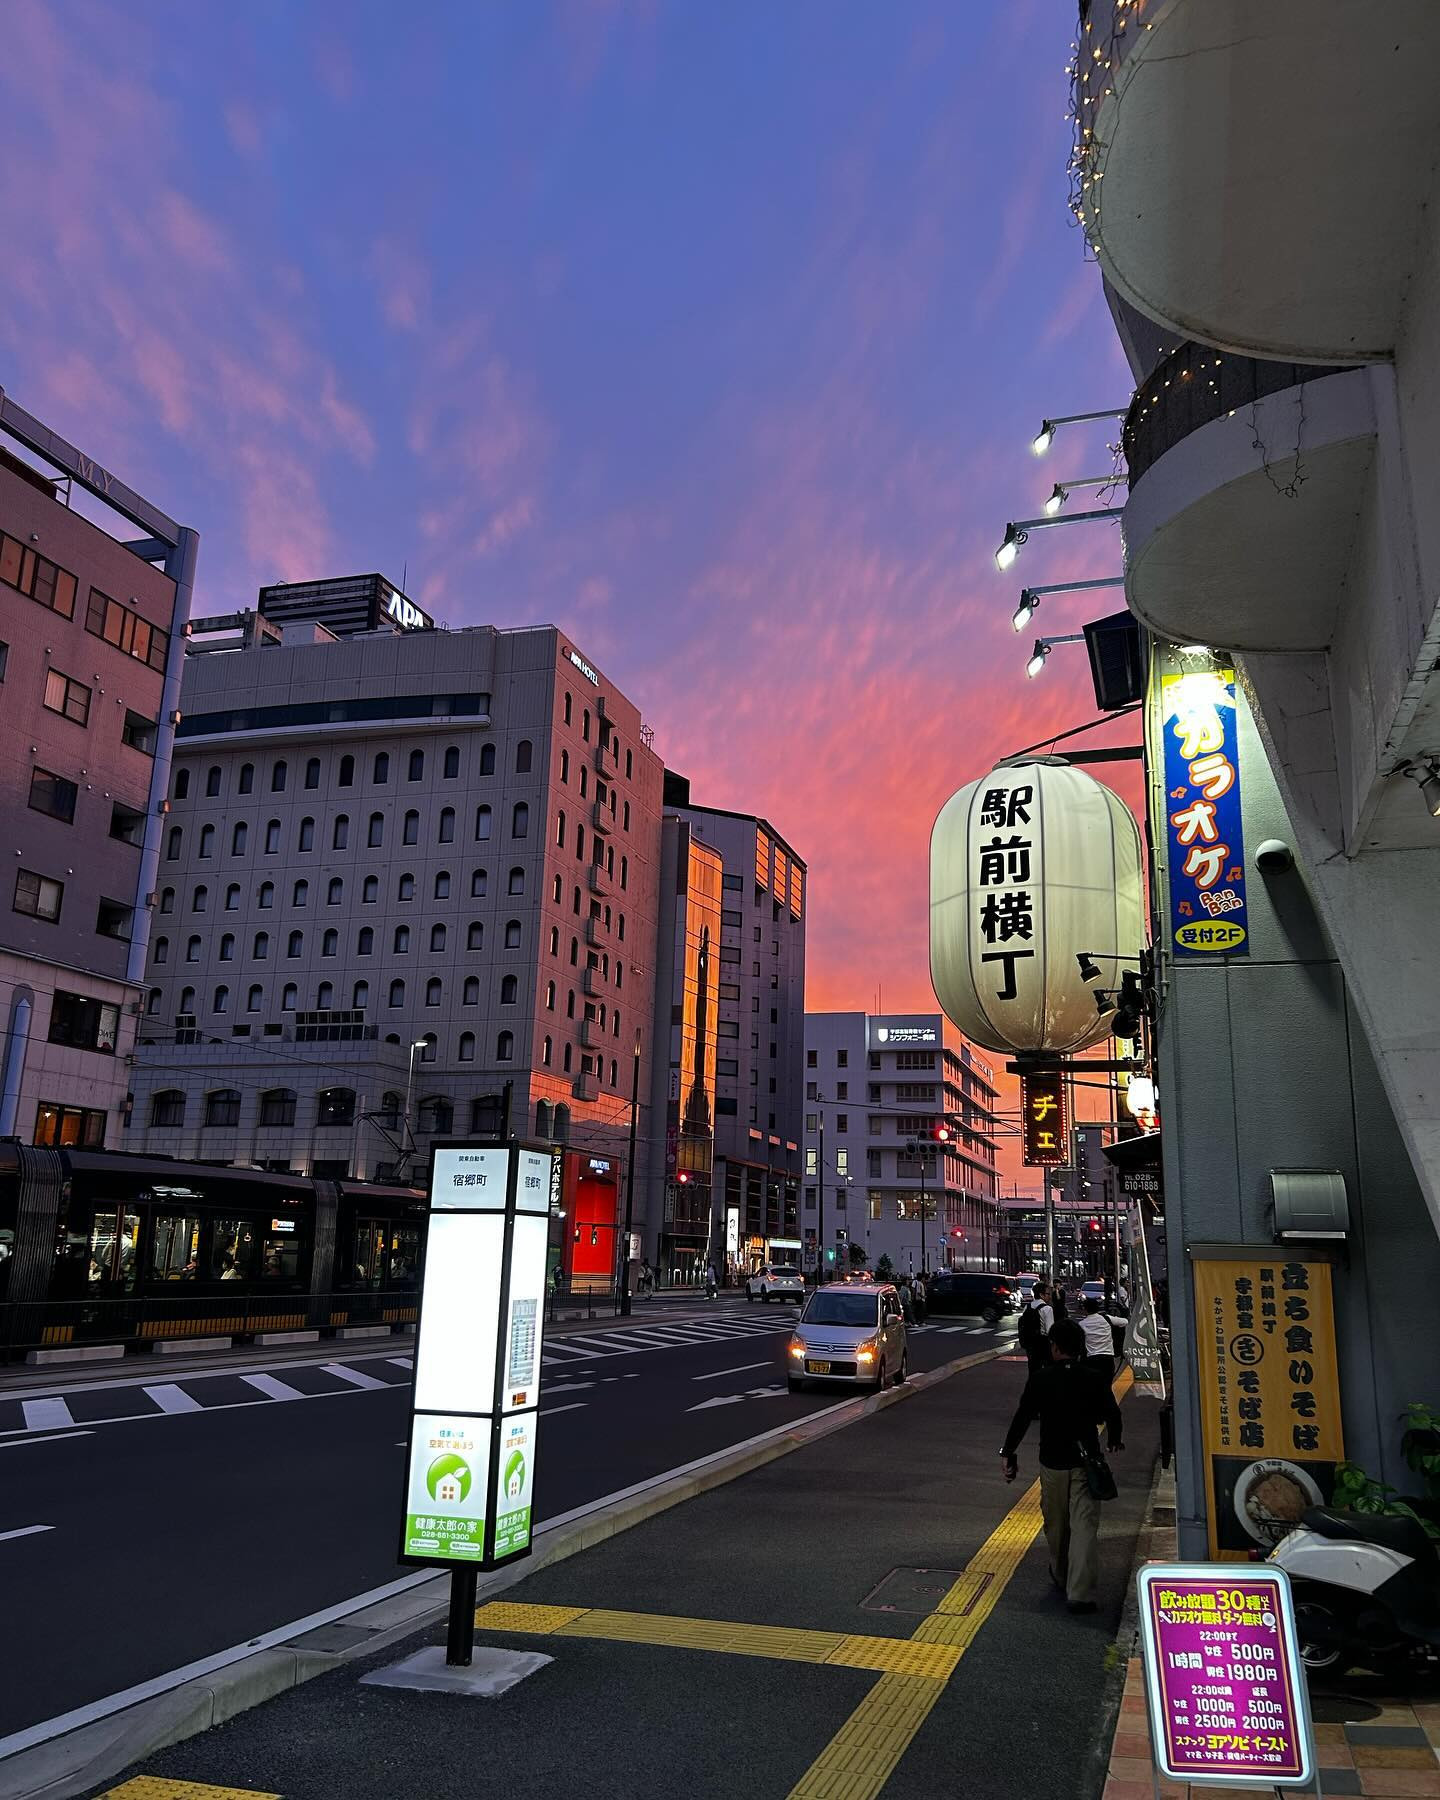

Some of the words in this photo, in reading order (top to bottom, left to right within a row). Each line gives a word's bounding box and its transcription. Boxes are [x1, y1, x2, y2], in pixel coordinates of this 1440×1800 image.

[388, 591, 424, 627] APA
[581, 662, 600, 687] HOTEL
[980, 785, 1035, 1001] 駅前横丁
[1199, 888, 1235, 908] Ban
[1207, 897, 1244, 917] Ban
[1181, 927, 1242, 944] 受付2F
[889, 1034, 936, 1042] シンフォニー病院
[453, 1174, 488, 1187] 宿郷町
[550, 1155, 562, 1203] アパホテル
[1260, 1268, 1277, 1334] 駅前横丁
[1281, 1262, 1320, 1451] 立ち食いそば
[415, 1517, 478, 1533] 健康太郎の家
[1168, 1652, 1203, 1669] 1時間
[1230, 1643, 1275, 1661] 500円
[1226, 1664, 1278, 1682] 1980円
[1196, 1698, 1235, 1713] 1000円
[1248, 1699, 1283, 1714] 500円
[1194, 1714, 1237, 1729] 2500円
[1242, 1715, 1285, 1730] 2000円
[1175, 1735, 1206, 1747] スナック
[1206, 1734, 1251, 1751] ヨアソビ
[1252, 1736, 1289, 1752] イースト
